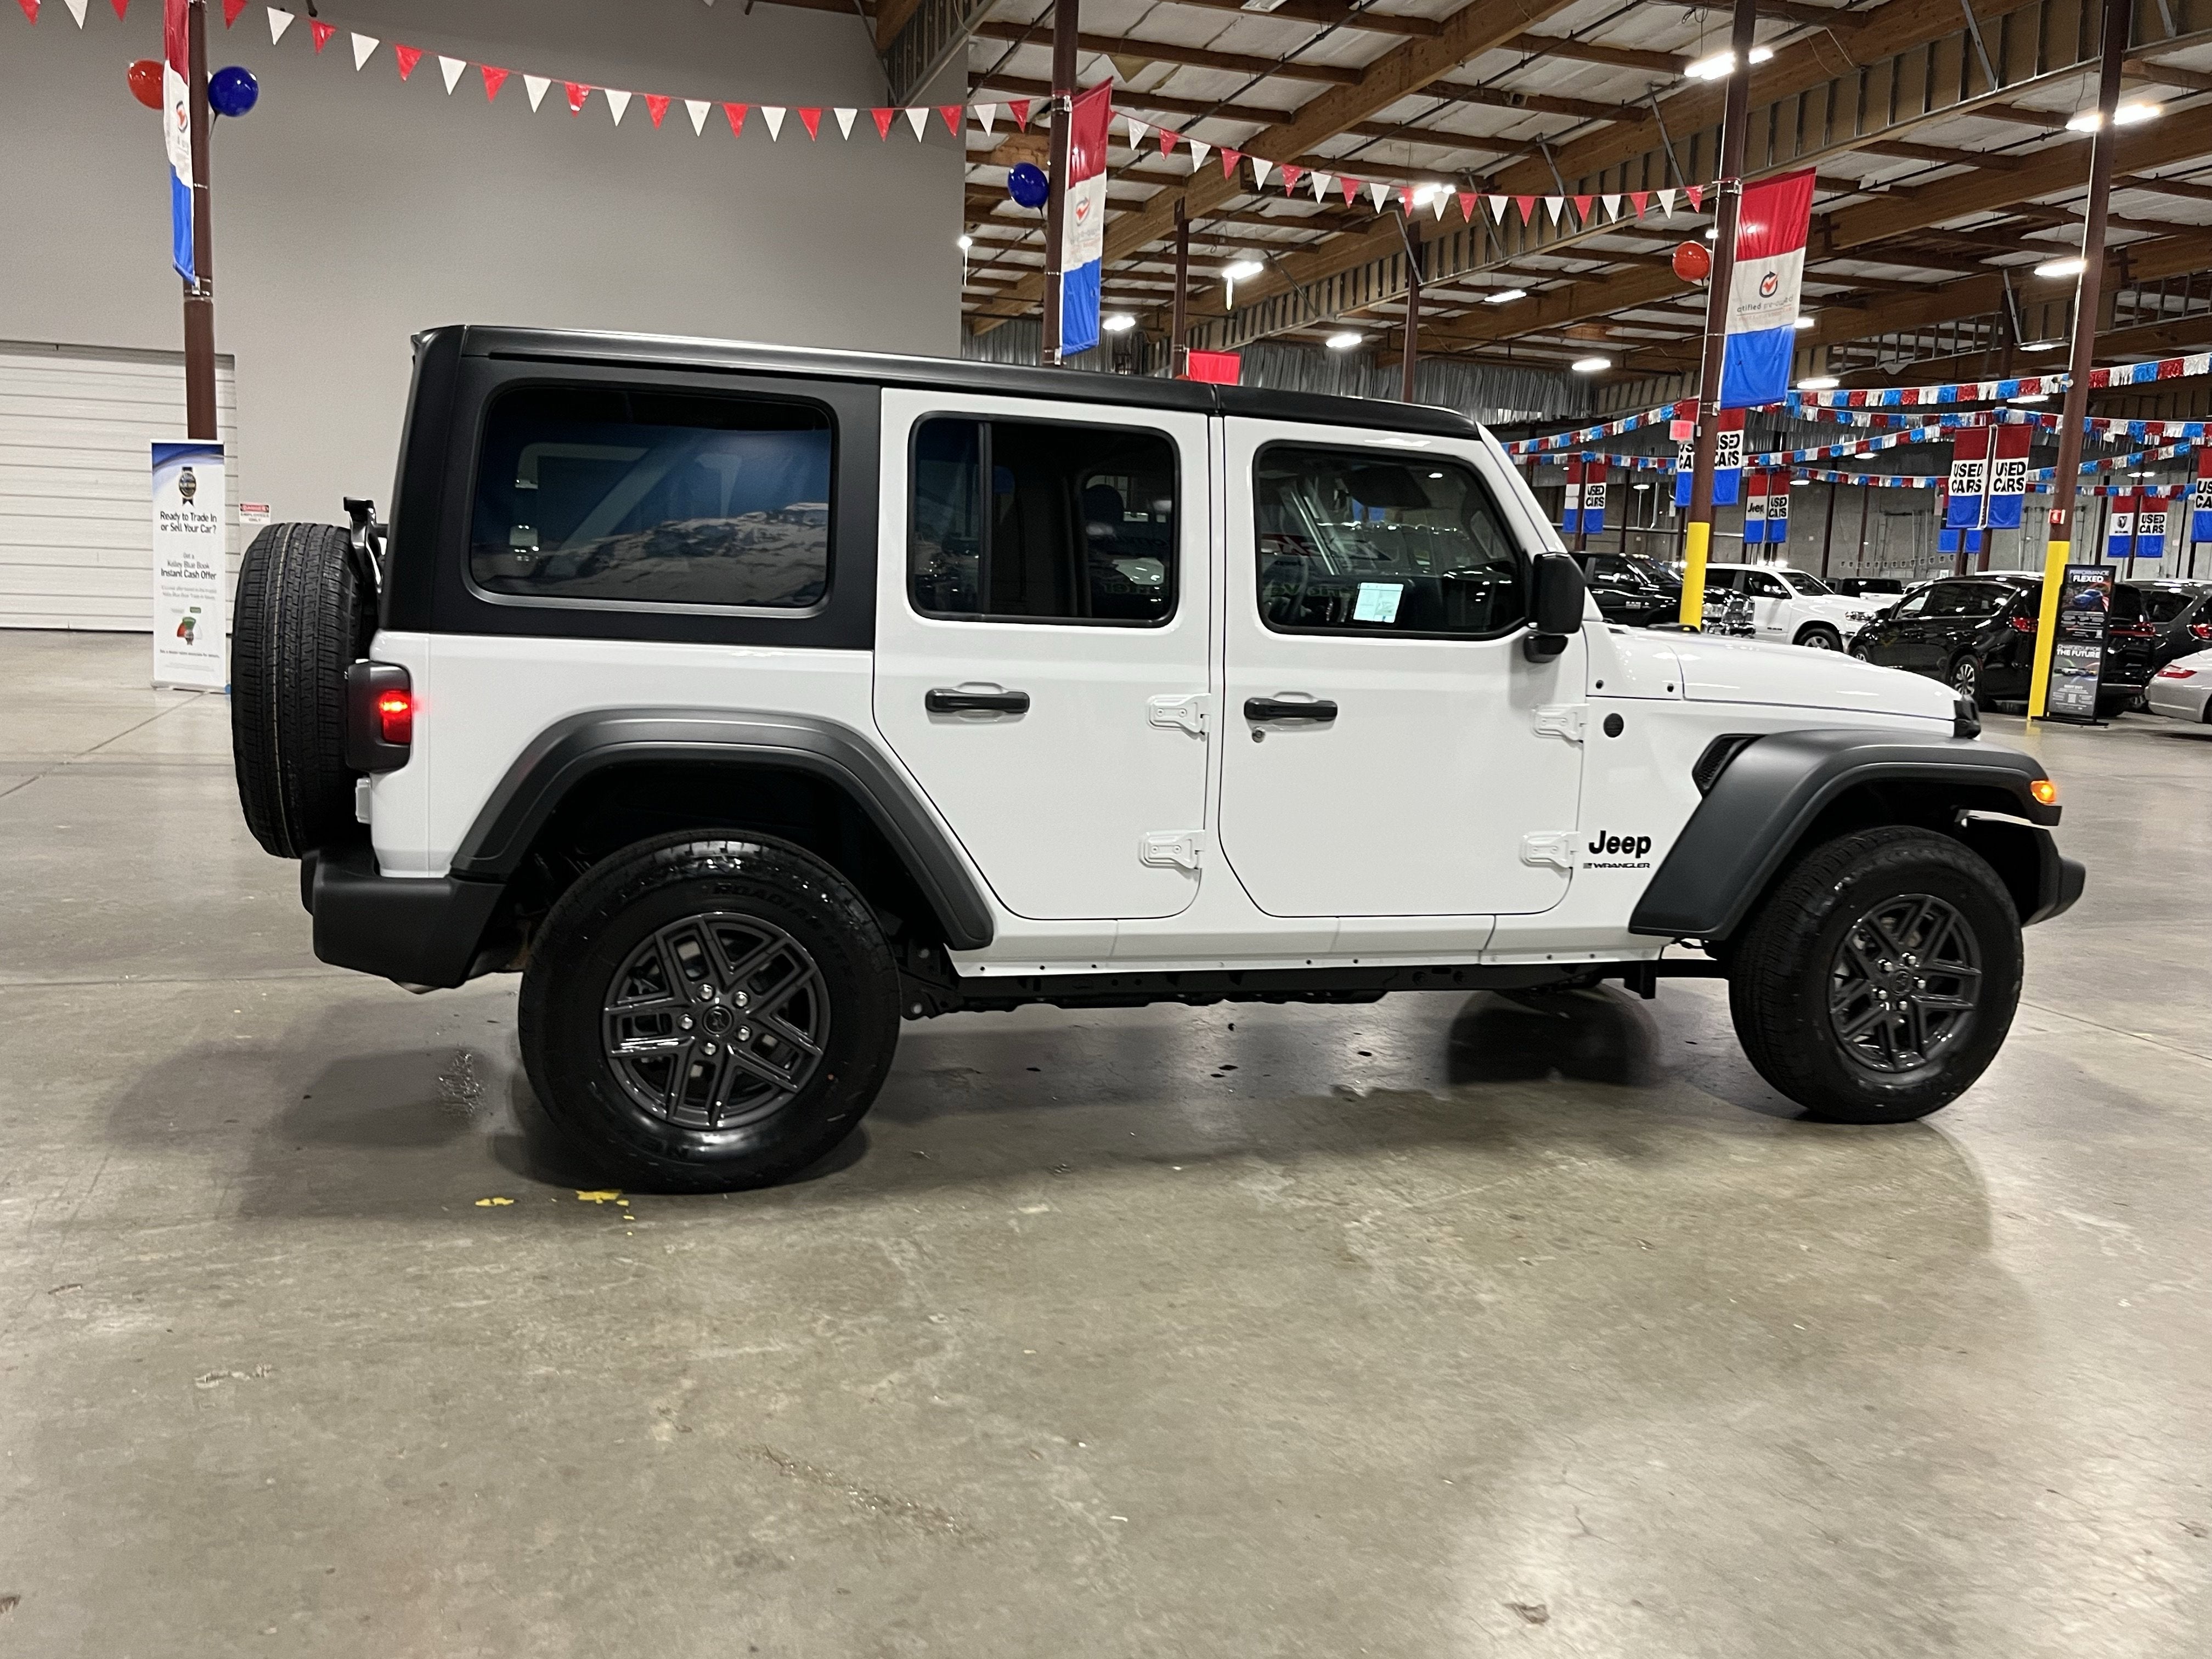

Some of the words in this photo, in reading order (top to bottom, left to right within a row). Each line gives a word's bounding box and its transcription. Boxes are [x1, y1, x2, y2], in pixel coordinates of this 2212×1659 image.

[1954, 464, 1983, 477] USED
[1588, 485, 1605, 495] USED
[1951, 479, 1982, 493] CARS
[160, 511, 180, 522] Ready
[182, 513, 189, 521] to
[190, 512, 209, 522] Trade
[211, 514, 217, 522] In
[2142, 514, 2165, 524] USED
[170, 522, 183, 532] Sell
[184, 523, 199, 533] Your
[200, 524, 217, 534] Car?
[2140, 524, 2164, 534] CARS
[161, 568, 183, 578] Instant
[184, 569, 199, 578] Cash
[201, 571, 217, 580] Offer
[2071, 650, 2100, 658] FUTURE
[1589, 830, 1651, 859] Jeep
